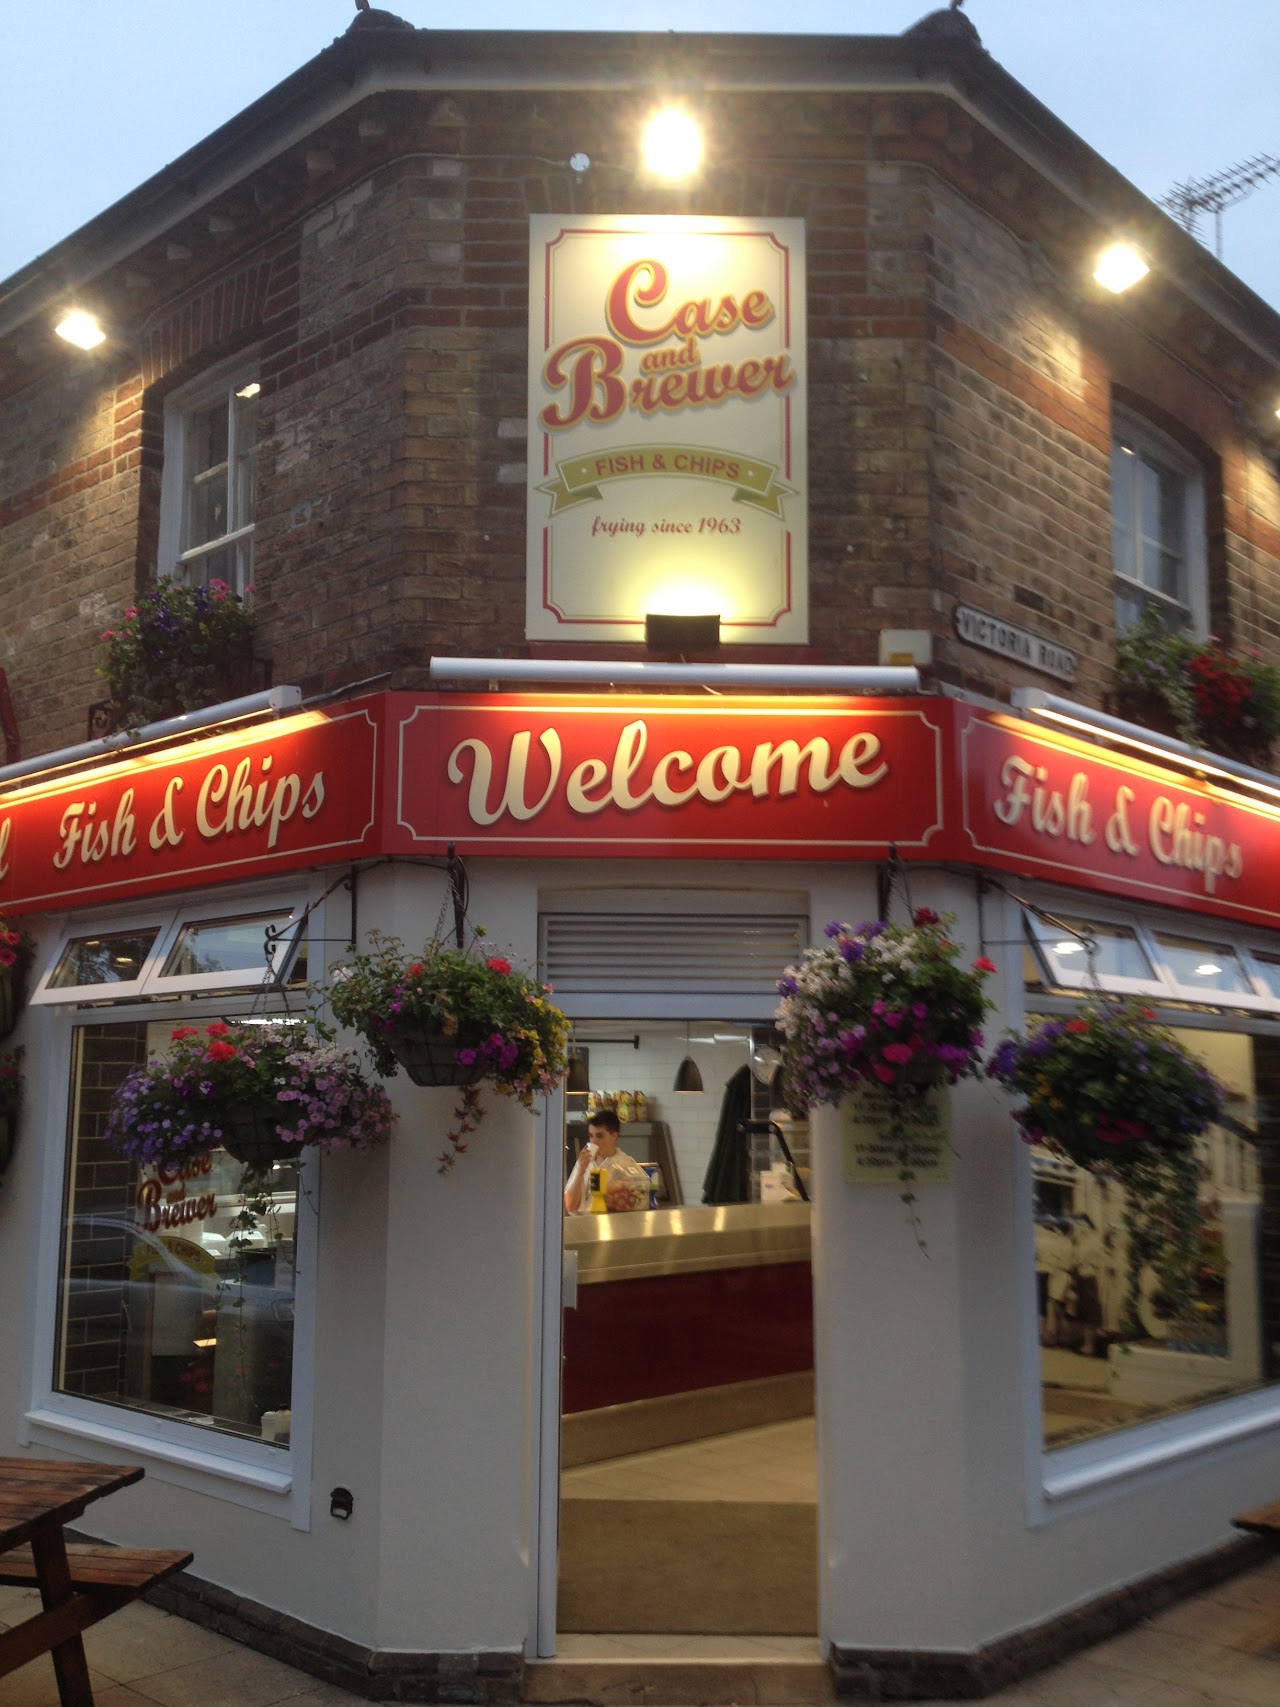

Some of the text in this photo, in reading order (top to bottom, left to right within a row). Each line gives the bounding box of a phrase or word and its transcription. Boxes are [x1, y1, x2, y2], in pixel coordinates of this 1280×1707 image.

[609, 258, 774, 345] Case
[541, 337, 795, 428] Brewer
[641, 340, 699, 371] and
[595, 453, 740, 480] FISH & CHIPS
[591, 516, 742, 537] frying since 1963
[958, 608, 1075, 676] VICTORIA ROAD
[447, 720, 889, 825] Welcome
[53, 787, 136, 869] Fish
[149, 776, 183, 850] &
[196, 754, 325, 848] Chips
[994, 755, 1242, 894] Fish & Chips
[137, 1180, 217, 1232] Brewer
